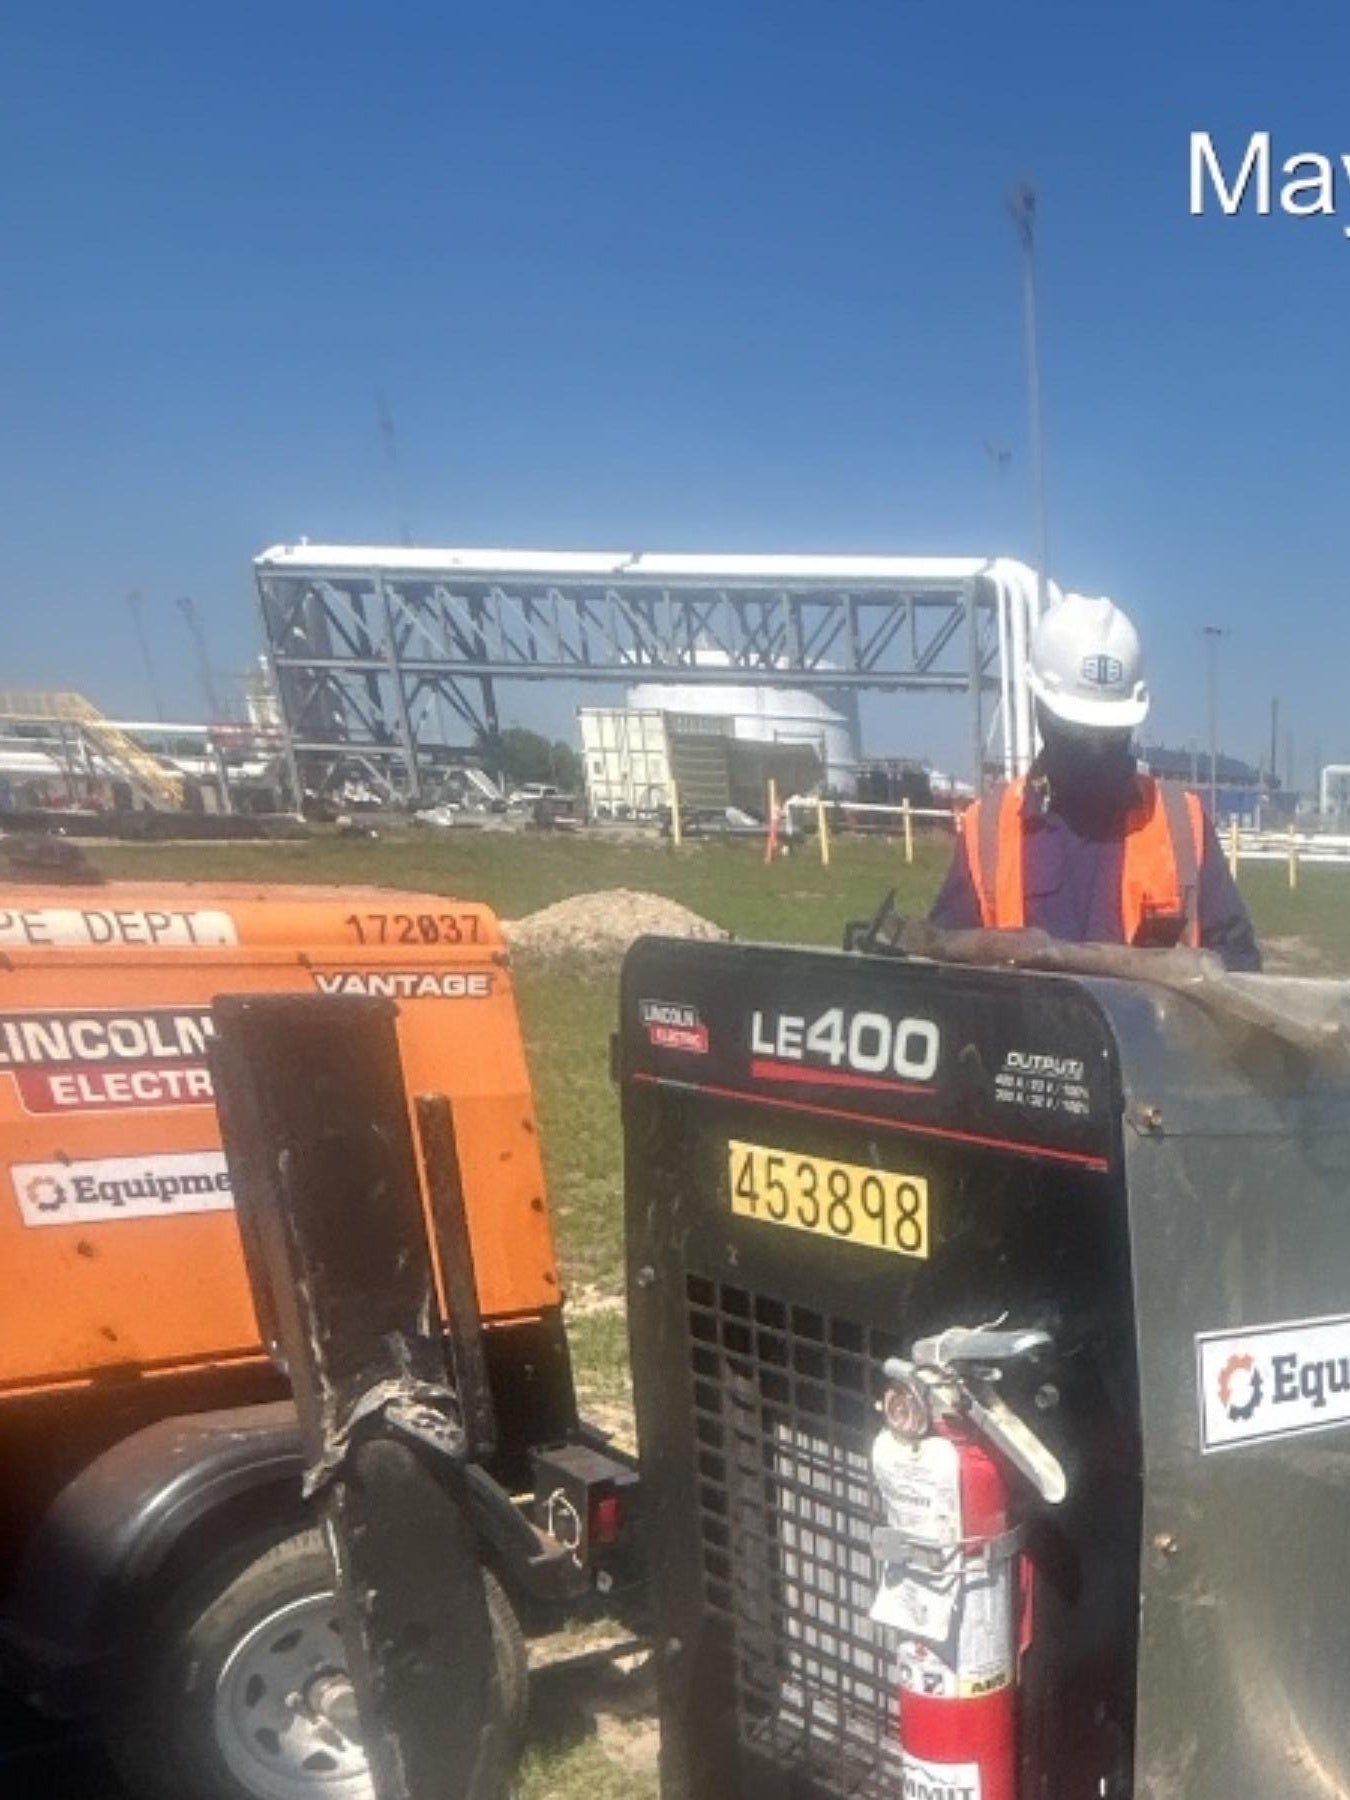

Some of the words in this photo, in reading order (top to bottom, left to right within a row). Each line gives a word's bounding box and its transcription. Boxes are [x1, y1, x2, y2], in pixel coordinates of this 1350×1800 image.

[81, 911, 226, 945] DEPT.
[345, 914, 483, 945] 172037
[315, 972, 491, 997] VANTAGE
[752, 1007, 941, 1081] LE400
[734, 1151, 923, 1252] 453898
